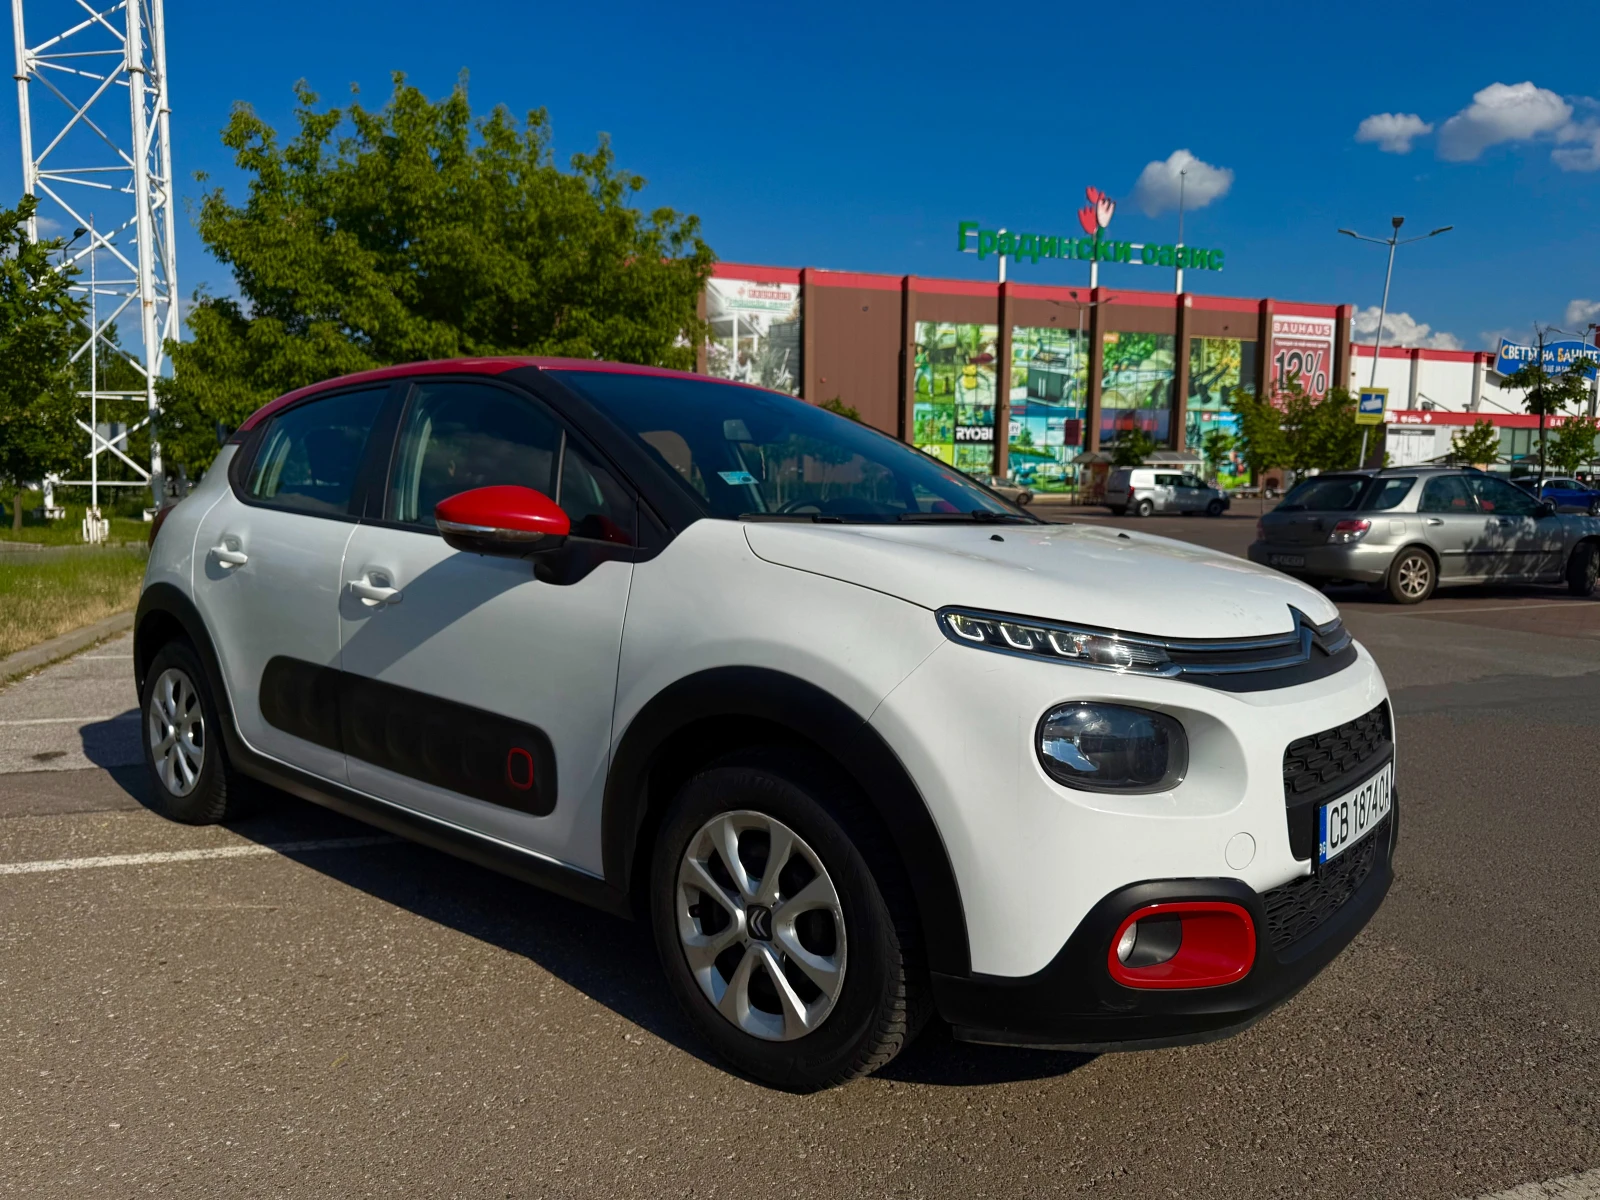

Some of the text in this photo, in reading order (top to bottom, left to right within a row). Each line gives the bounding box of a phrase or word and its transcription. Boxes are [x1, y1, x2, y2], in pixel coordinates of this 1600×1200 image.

[957, 220, 1225, 271] Градински оазис
[1273, 322, 1330, 335] BAUHAUS
[1542, 350, 1555, 362] НА
[1275, 350, 1326, 395] 12%
[955, 426, 994, 441] RYOBI
[1353, 778, 1378, 834] 1874
